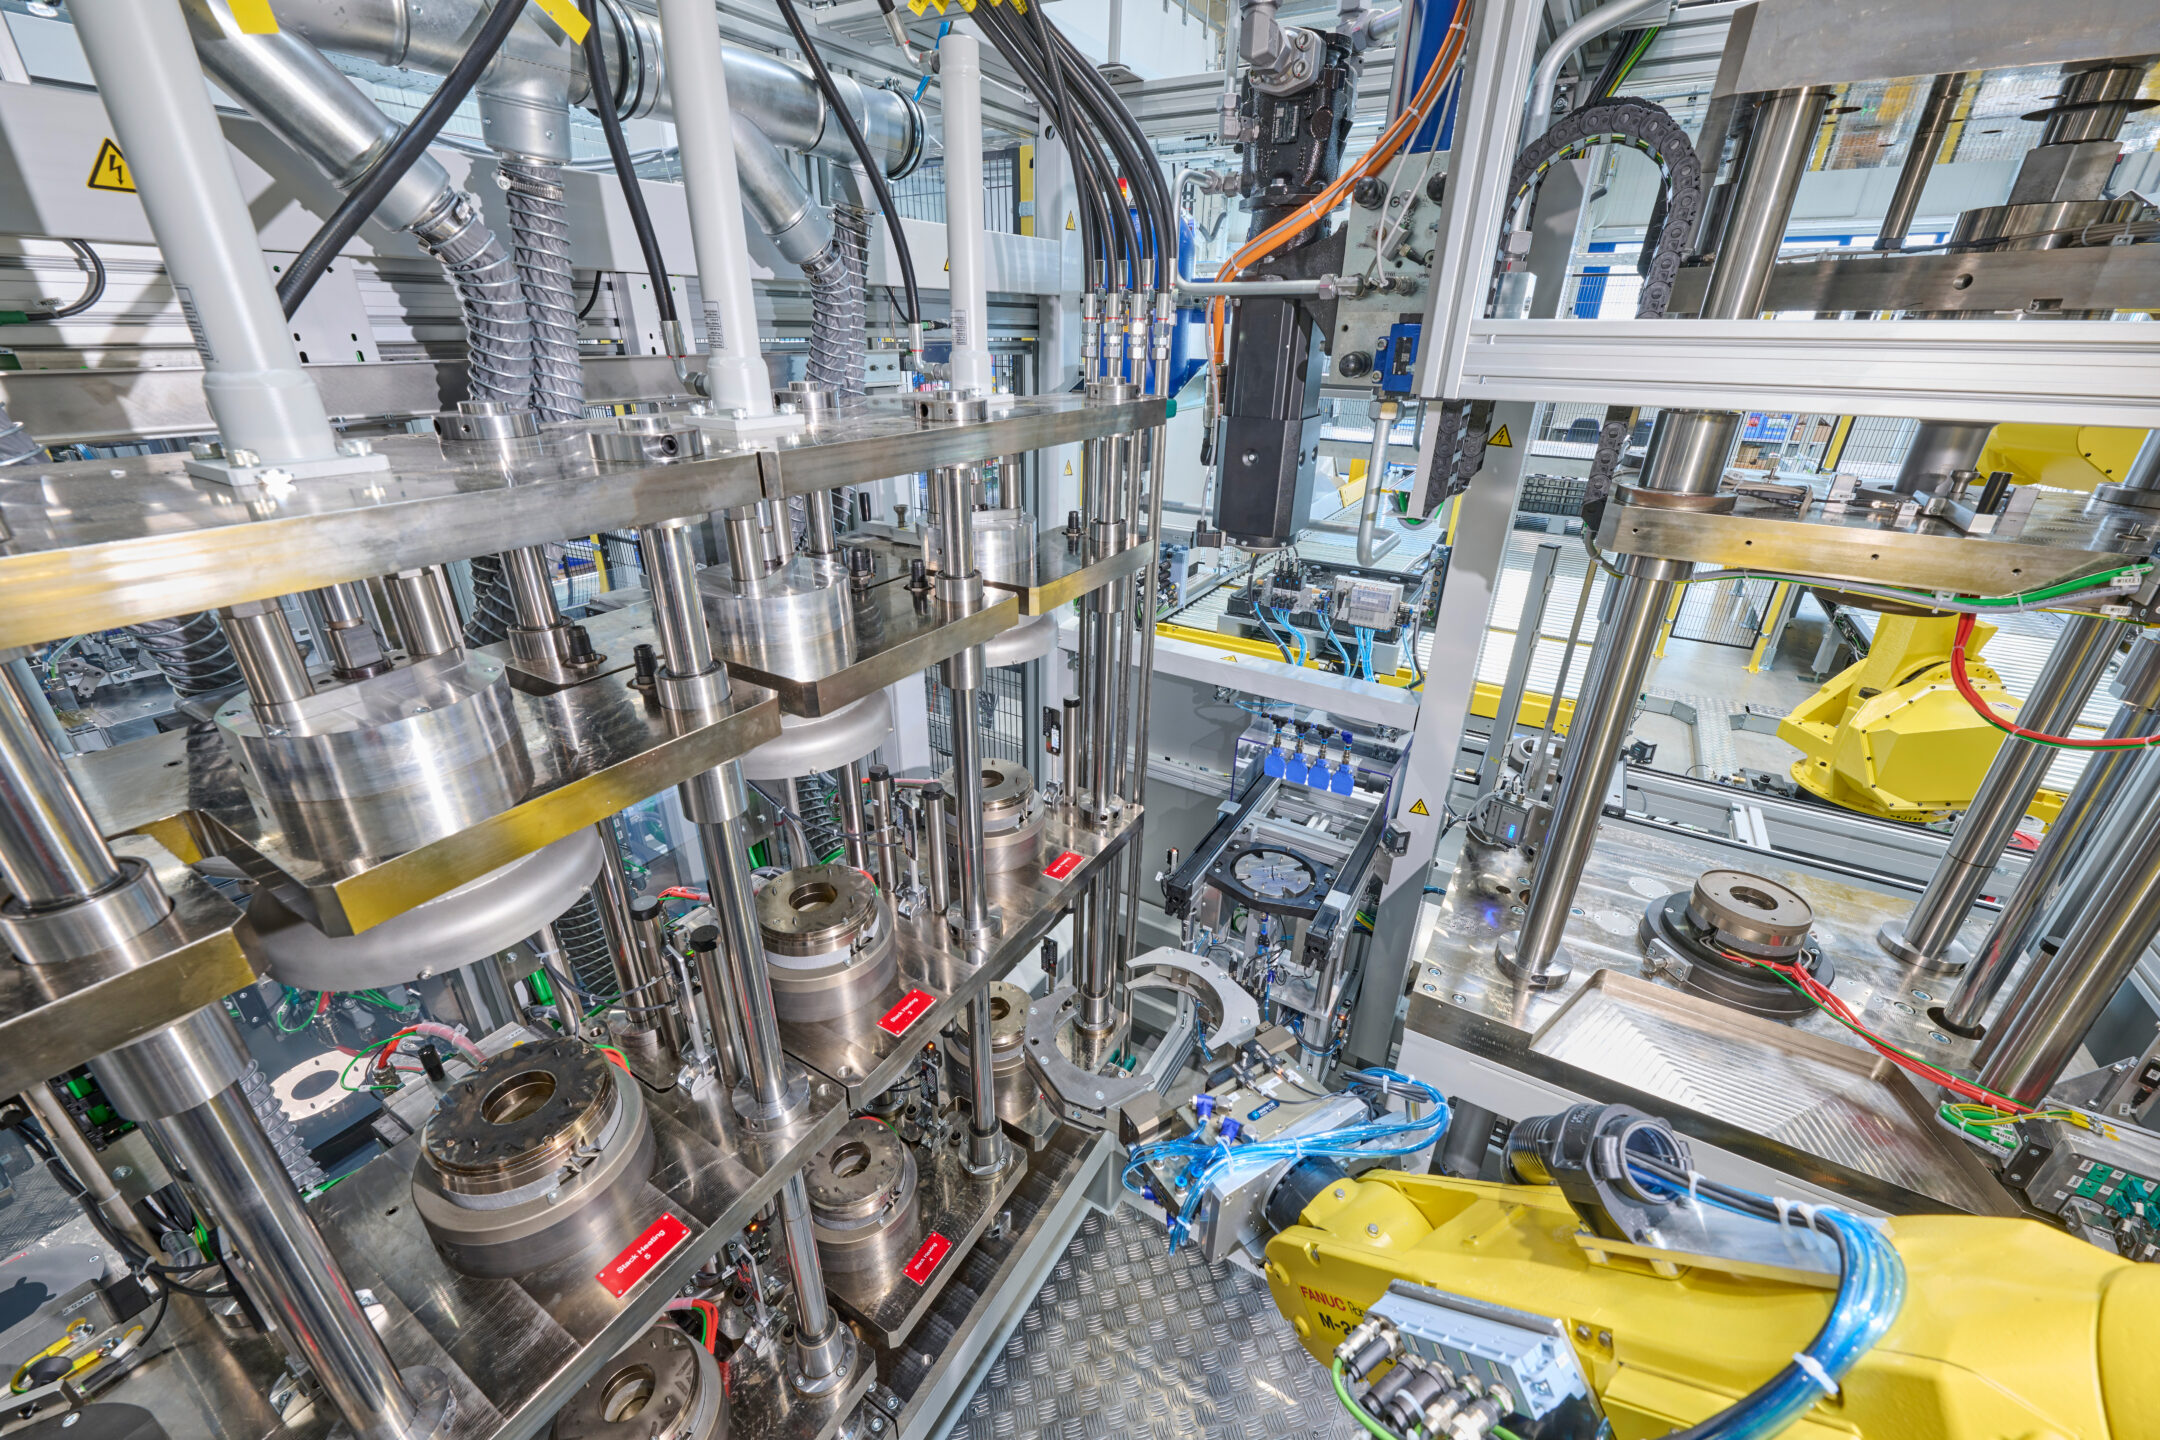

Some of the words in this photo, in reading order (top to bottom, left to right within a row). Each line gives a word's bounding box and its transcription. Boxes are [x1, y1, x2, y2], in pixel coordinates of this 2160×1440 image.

[616, 1253, 639, 1274] Stack
[637, 1229, 666, 1255] Heating
[643, 1252, 652, 1260] 5
[1300, 1285, 1347, 1312] FANUC
